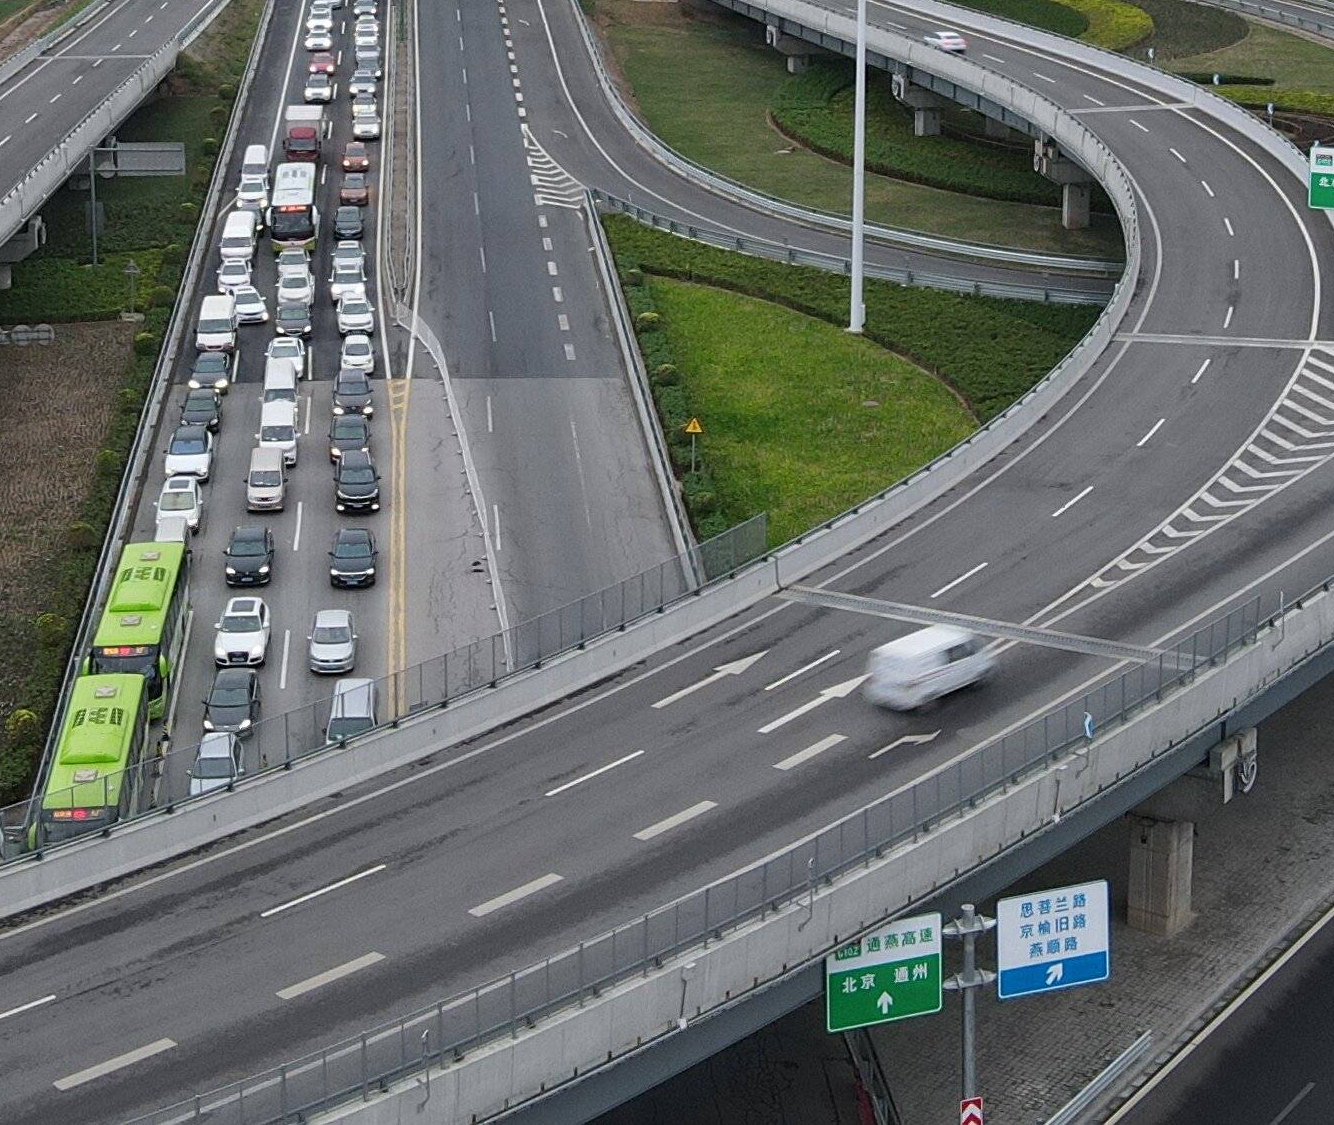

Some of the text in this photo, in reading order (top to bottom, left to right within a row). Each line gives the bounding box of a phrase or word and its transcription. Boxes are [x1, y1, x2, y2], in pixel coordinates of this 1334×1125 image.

[867, 927, 934, 953] 通燕高速
[842, 962, 928, 994] 北京 通州
